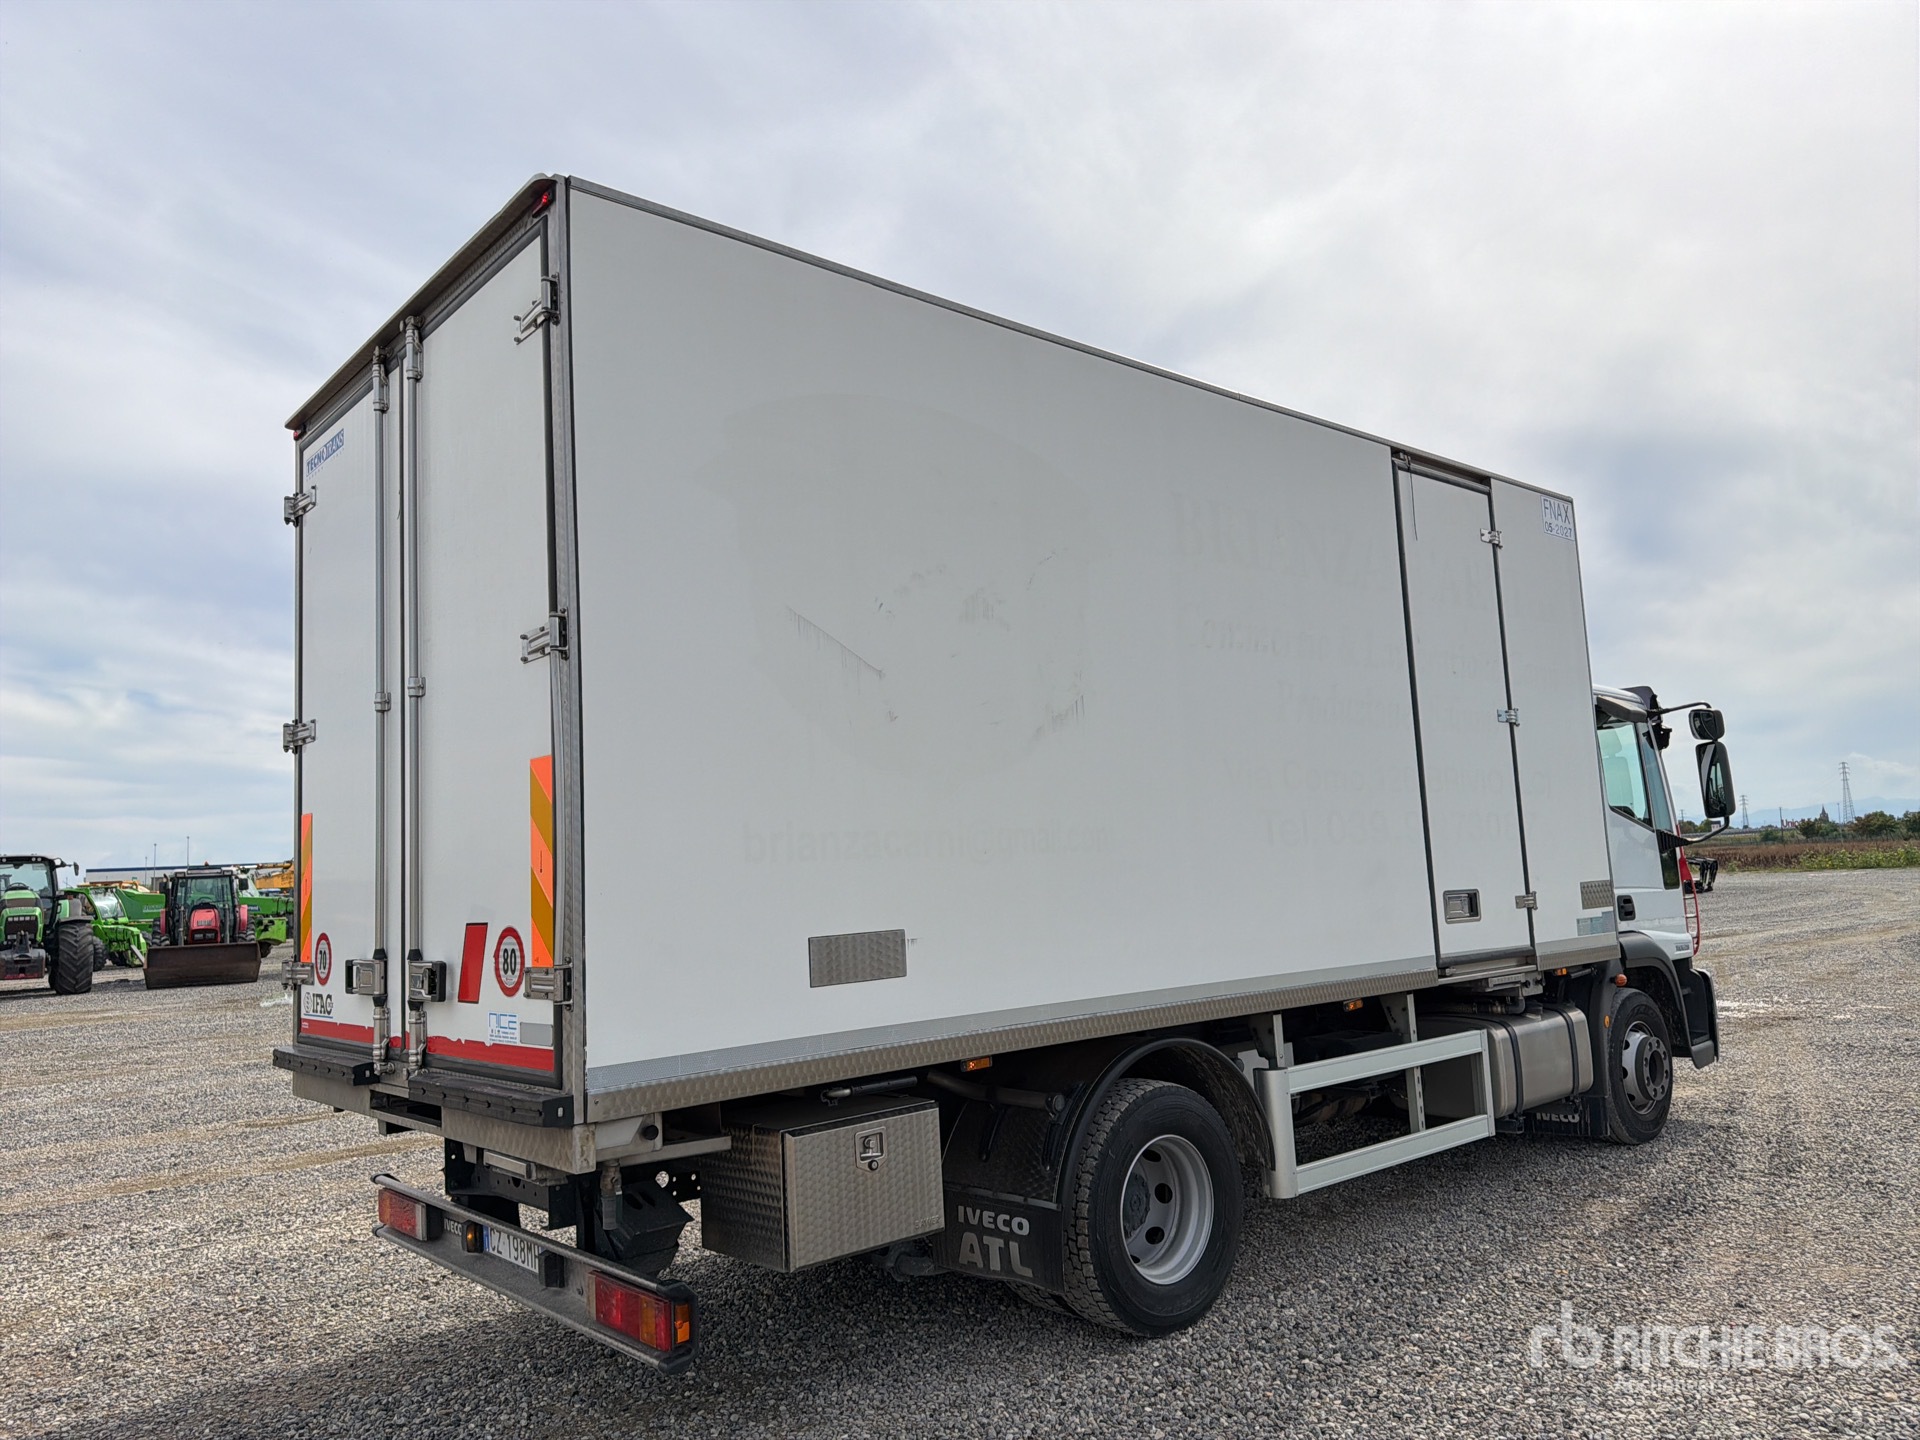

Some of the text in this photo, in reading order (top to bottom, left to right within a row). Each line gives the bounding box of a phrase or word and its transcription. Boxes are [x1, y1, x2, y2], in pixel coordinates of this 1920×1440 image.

[1543, 498, 1571, 525] FNAX
[1544, 520, 1573, 538] 05-2027
[319, 949, 327, 970] 70
[502, 947, 517, 976] 80
[958, 1205, 1030, 1236] IVECO
[959, 1231, 1033, 1278] ATL
